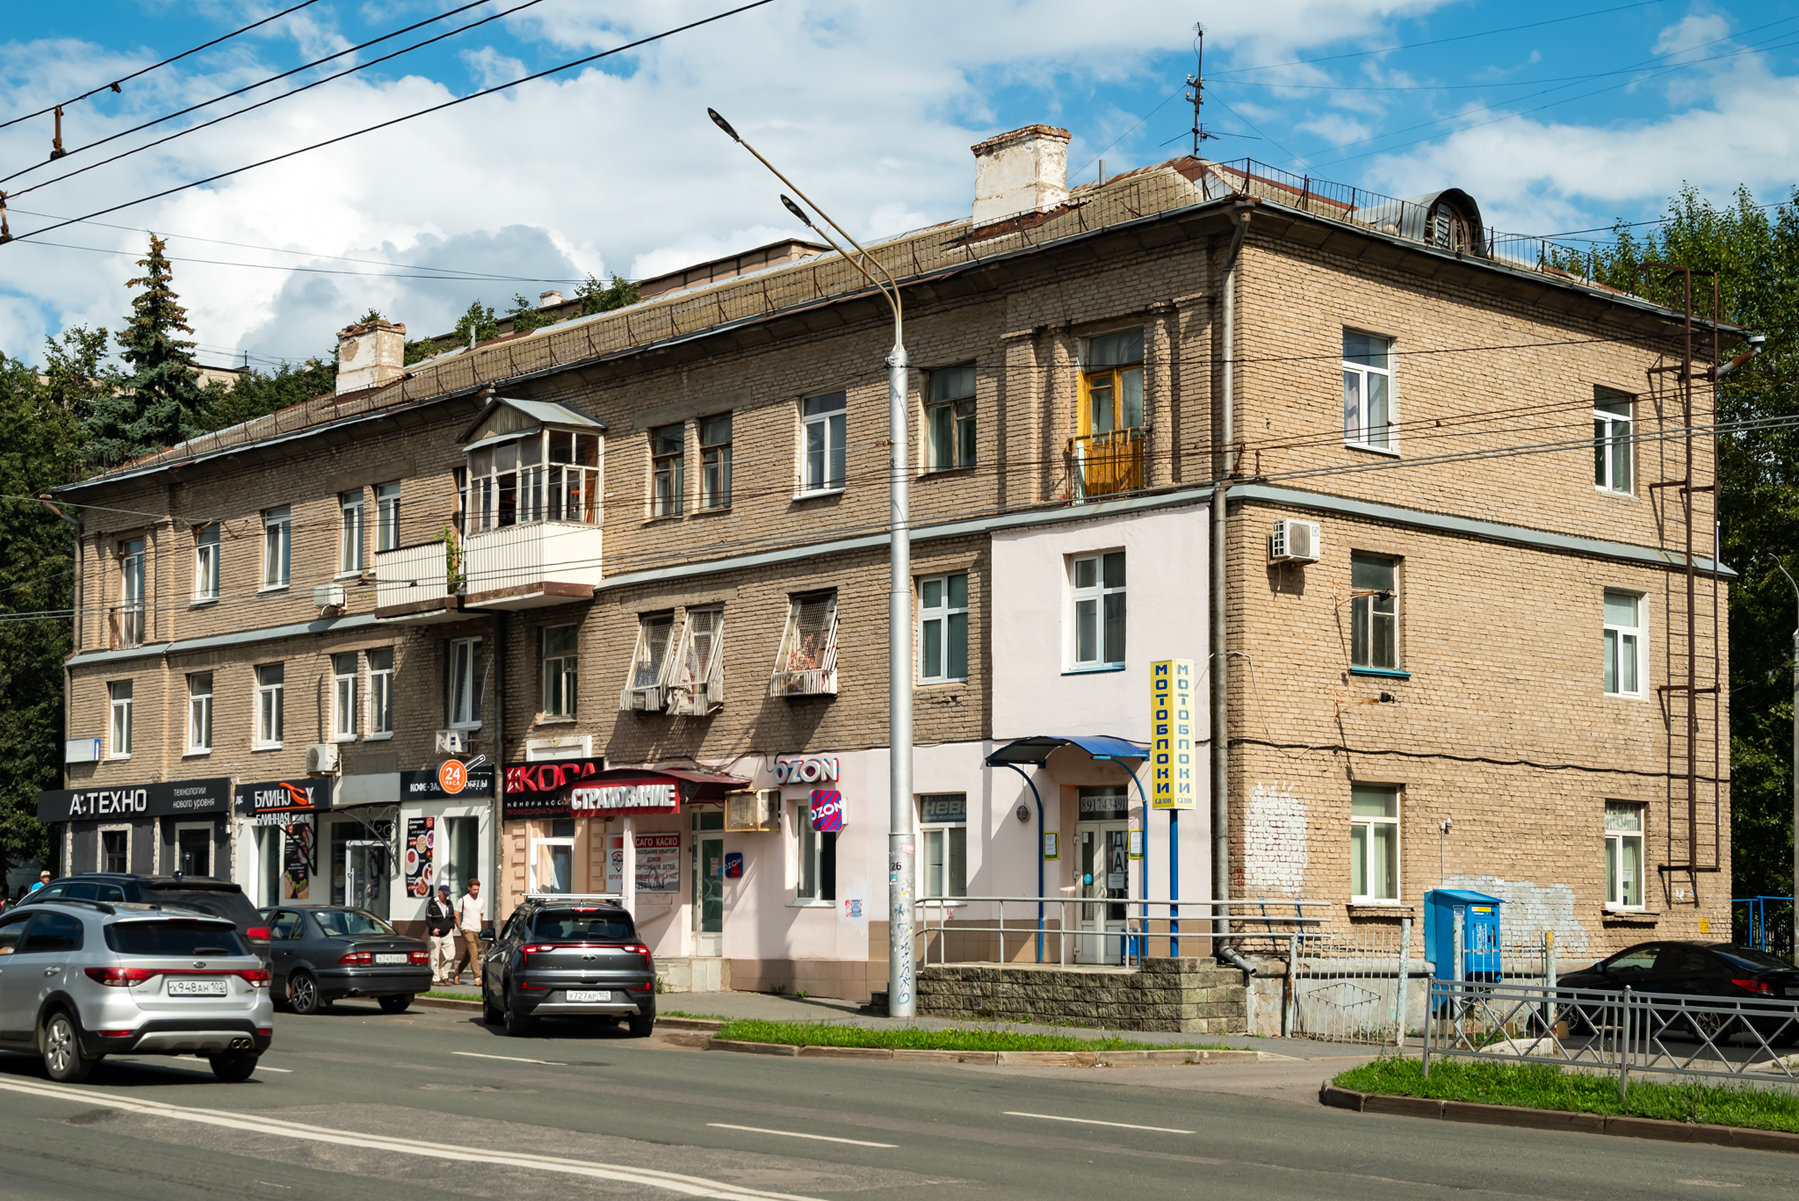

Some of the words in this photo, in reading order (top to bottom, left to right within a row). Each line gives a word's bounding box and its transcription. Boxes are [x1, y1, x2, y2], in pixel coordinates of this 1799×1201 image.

[445, 767, 461, 780] 24
[772, 757, 839, 786] OZON
[173, 786, 207, 797] технологии
[571, 784, 676, 811] СТРАХОВАНИЕ
[172, 799, 192, 809] нового
[193, 797, 216, 810] уровня
[811, 800, 842, 821] OZON
[256, 812, 290, 826] БЛИННАЯ
[655, 837, 678, 846] КАСКО
[891, 861, 902, 871] 26
